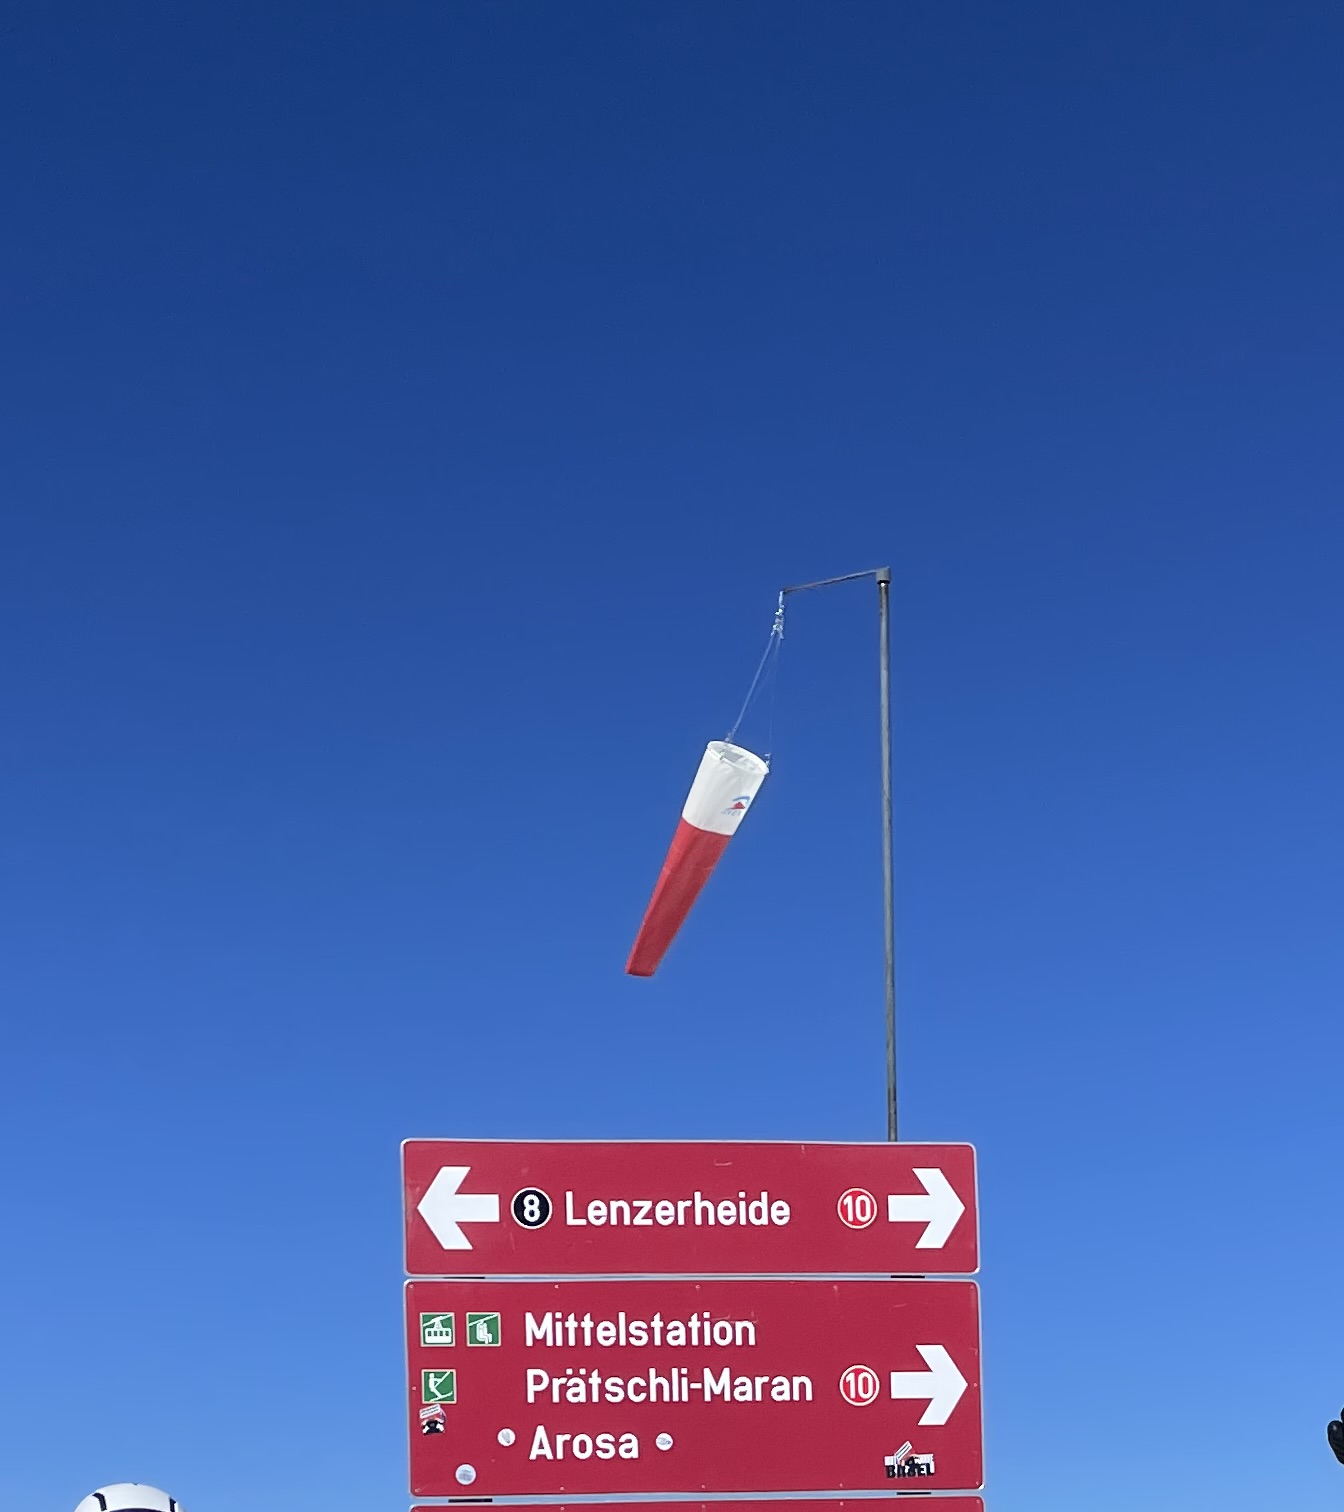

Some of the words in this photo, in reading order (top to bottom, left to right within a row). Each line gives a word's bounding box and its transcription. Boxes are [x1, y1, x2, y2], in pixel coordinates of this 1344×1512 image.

[523, 1194, 541, 1222] 8
[565, 1191, 791, 1226] Lenzerheide
[843, 1195, 871, 1222] 10
[524, 1311, 756, 1347] Mittelstation
[526, 1366, 813, 1404] Prätschli-Maran
[846, 1372, 874, 1400] 10
[529, 1425, 640, 1460] Arosa
